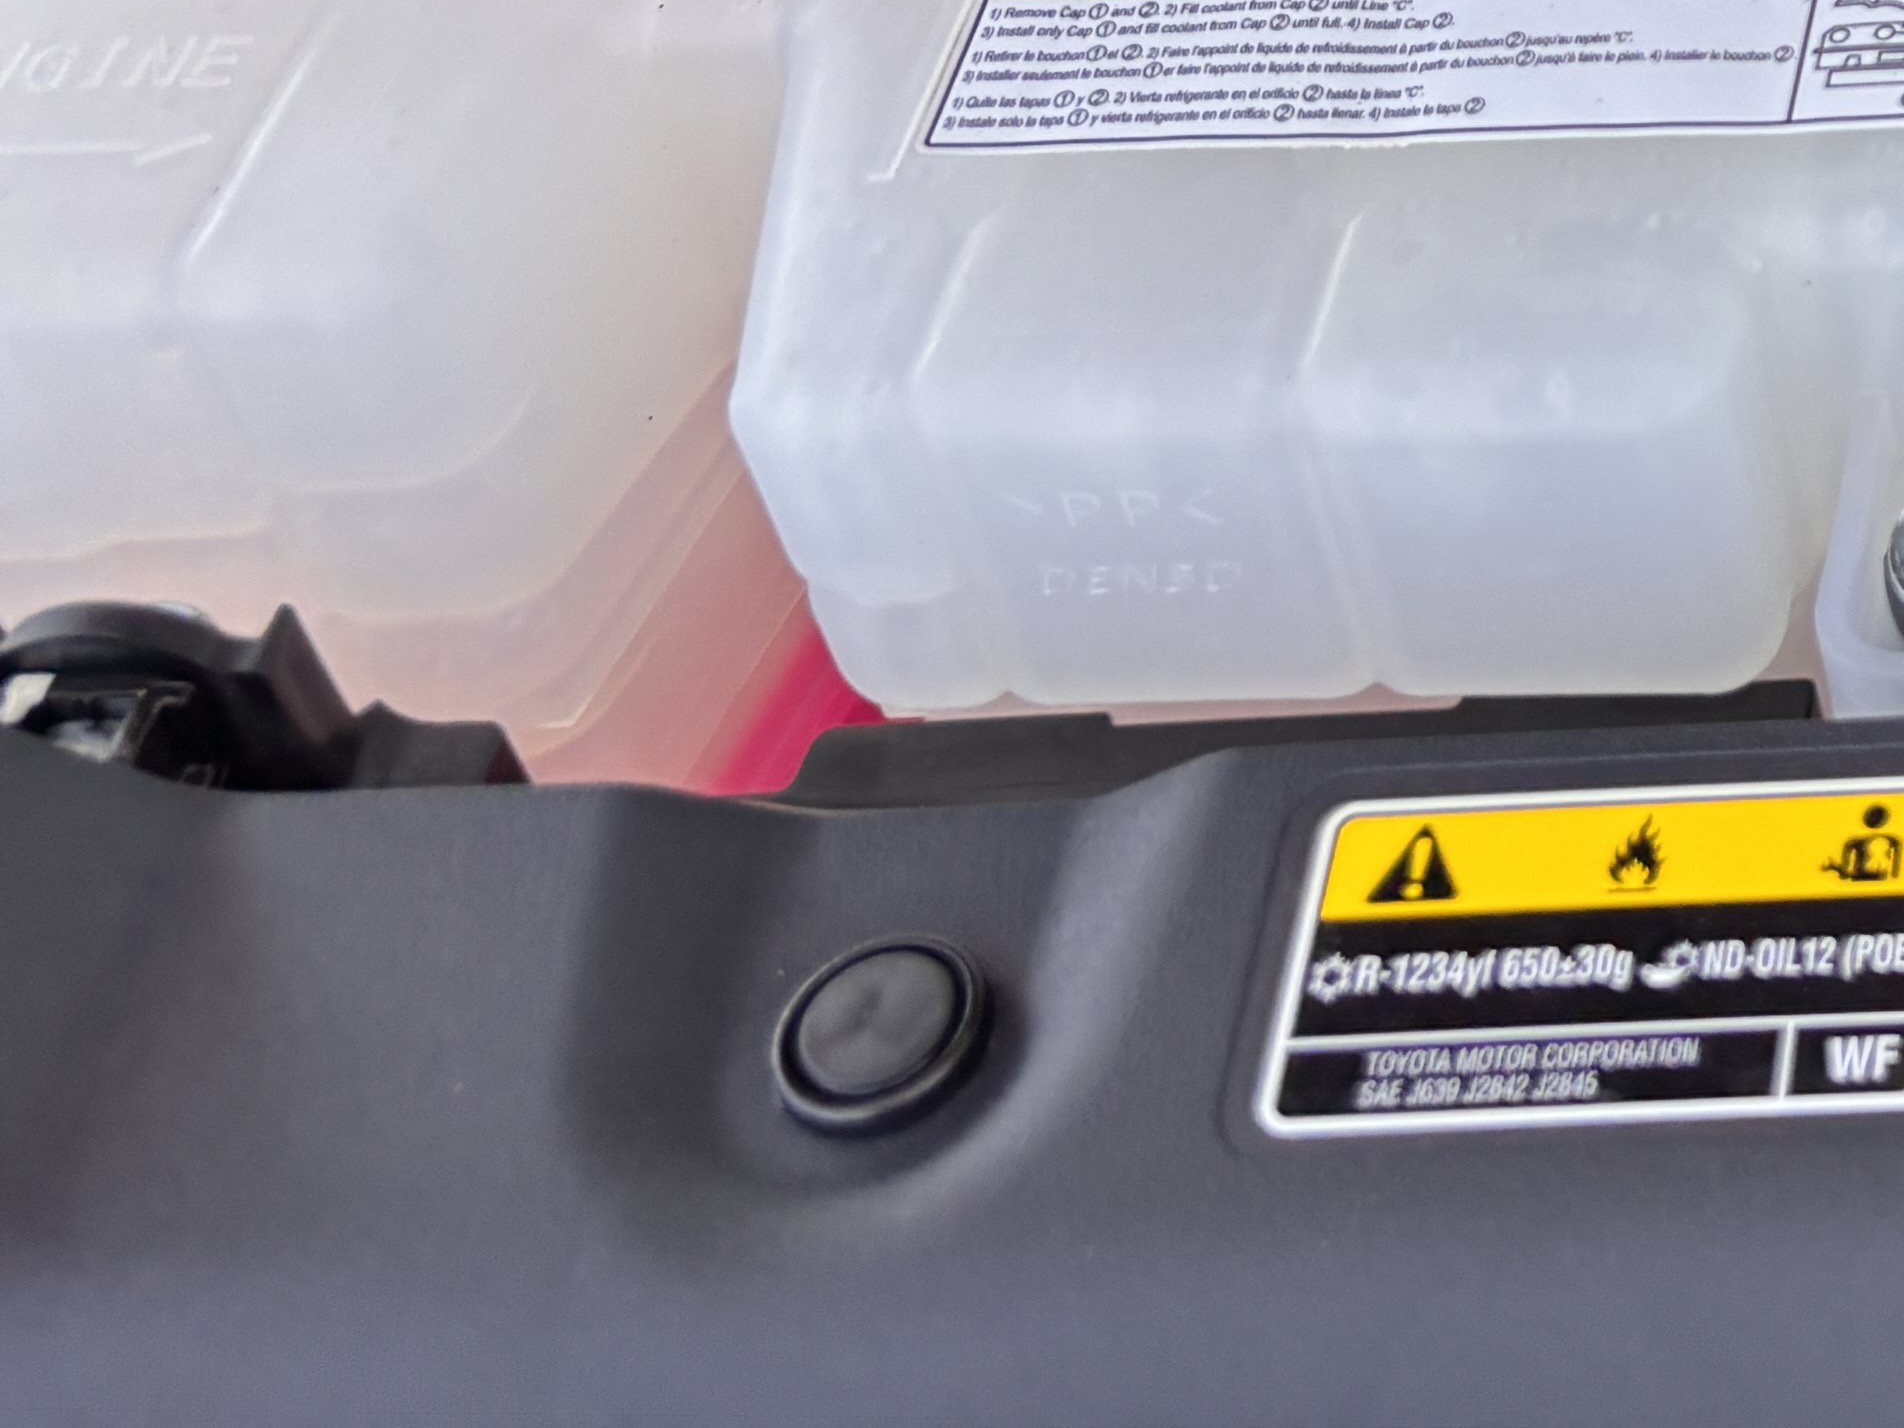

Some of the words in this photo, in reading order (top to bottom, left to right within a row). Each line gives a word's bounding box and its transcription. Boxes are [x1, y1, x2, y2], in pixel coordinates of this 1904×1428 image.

[996, 25, 1035, 37] Install
[1037, 25, 1065, 39] only
[1067, 24, 1093, 38] Cap
[1118, 23, 1142, 34] and
[1145, 22, 1160, 34] fill
[1161, 21, 1207, 34] coolant
[1209, 19, 1237, 31] from
[1240, 18, 1266, 32] Cap
[1292, 17, 1319, 29] until
[1364, 16, 1401, 29] Install
[1404, 17, 1430, 31] Cap
[1004, 7, 1056, 19] Remove
[1060, 6, 1086, 20] Cap
[1111, 5, 1135, 16] and
[1180, 2, 1199, 15] Fill
[1201, 1, 1246, 13] coolant
[1249, 0, 1277, 10] from
[1280, 0, 1305, 13] Cap
[1037, 49, 1086, 62] bouchon
[1354, 948, 1498, 999] R-1234yf
[1501, 942, 1635, 993] 650±30g
[1699, 935, 1837, 980] ND-OIL12
[1365, 1047, 1451, 1076] TOYOTA
[1454, 1043, 1538, 1073] MOTOR
[1541, 1036, 1701, 1070] CORPORATION
[1823, 1032, 1904, 1086] WF
[1354, 1077, 1403, 1110] SAE
